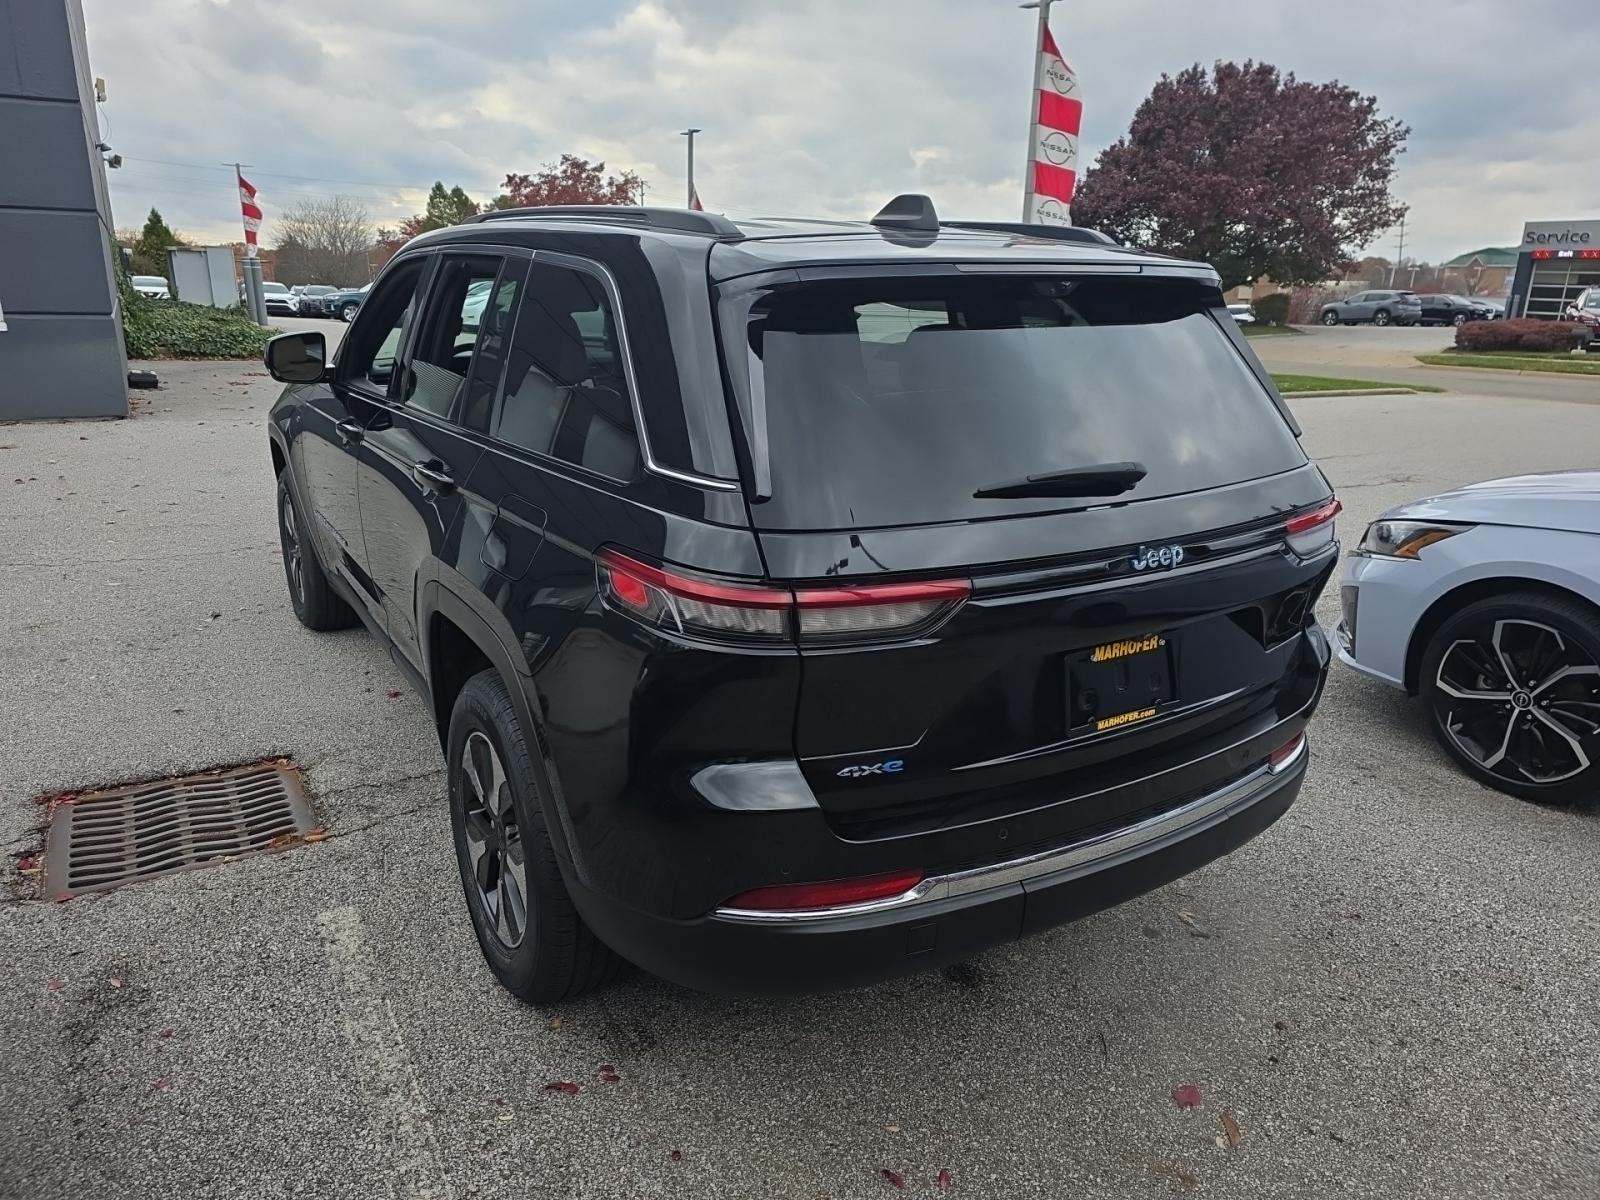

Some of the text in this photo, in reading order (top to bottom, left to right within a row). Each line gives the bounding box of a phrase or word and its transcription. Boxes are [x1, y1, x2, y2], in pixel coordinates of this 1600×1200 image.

[1040, 141, 1076, 156] NISSAN
[1525, 229, 1590, 244] Service
[1131, 545, 1184, 571] Jeep
[1094, 635, 1159, 661] MARHOFER
[1097, 708, 1156, 731] MARHOFER.com
